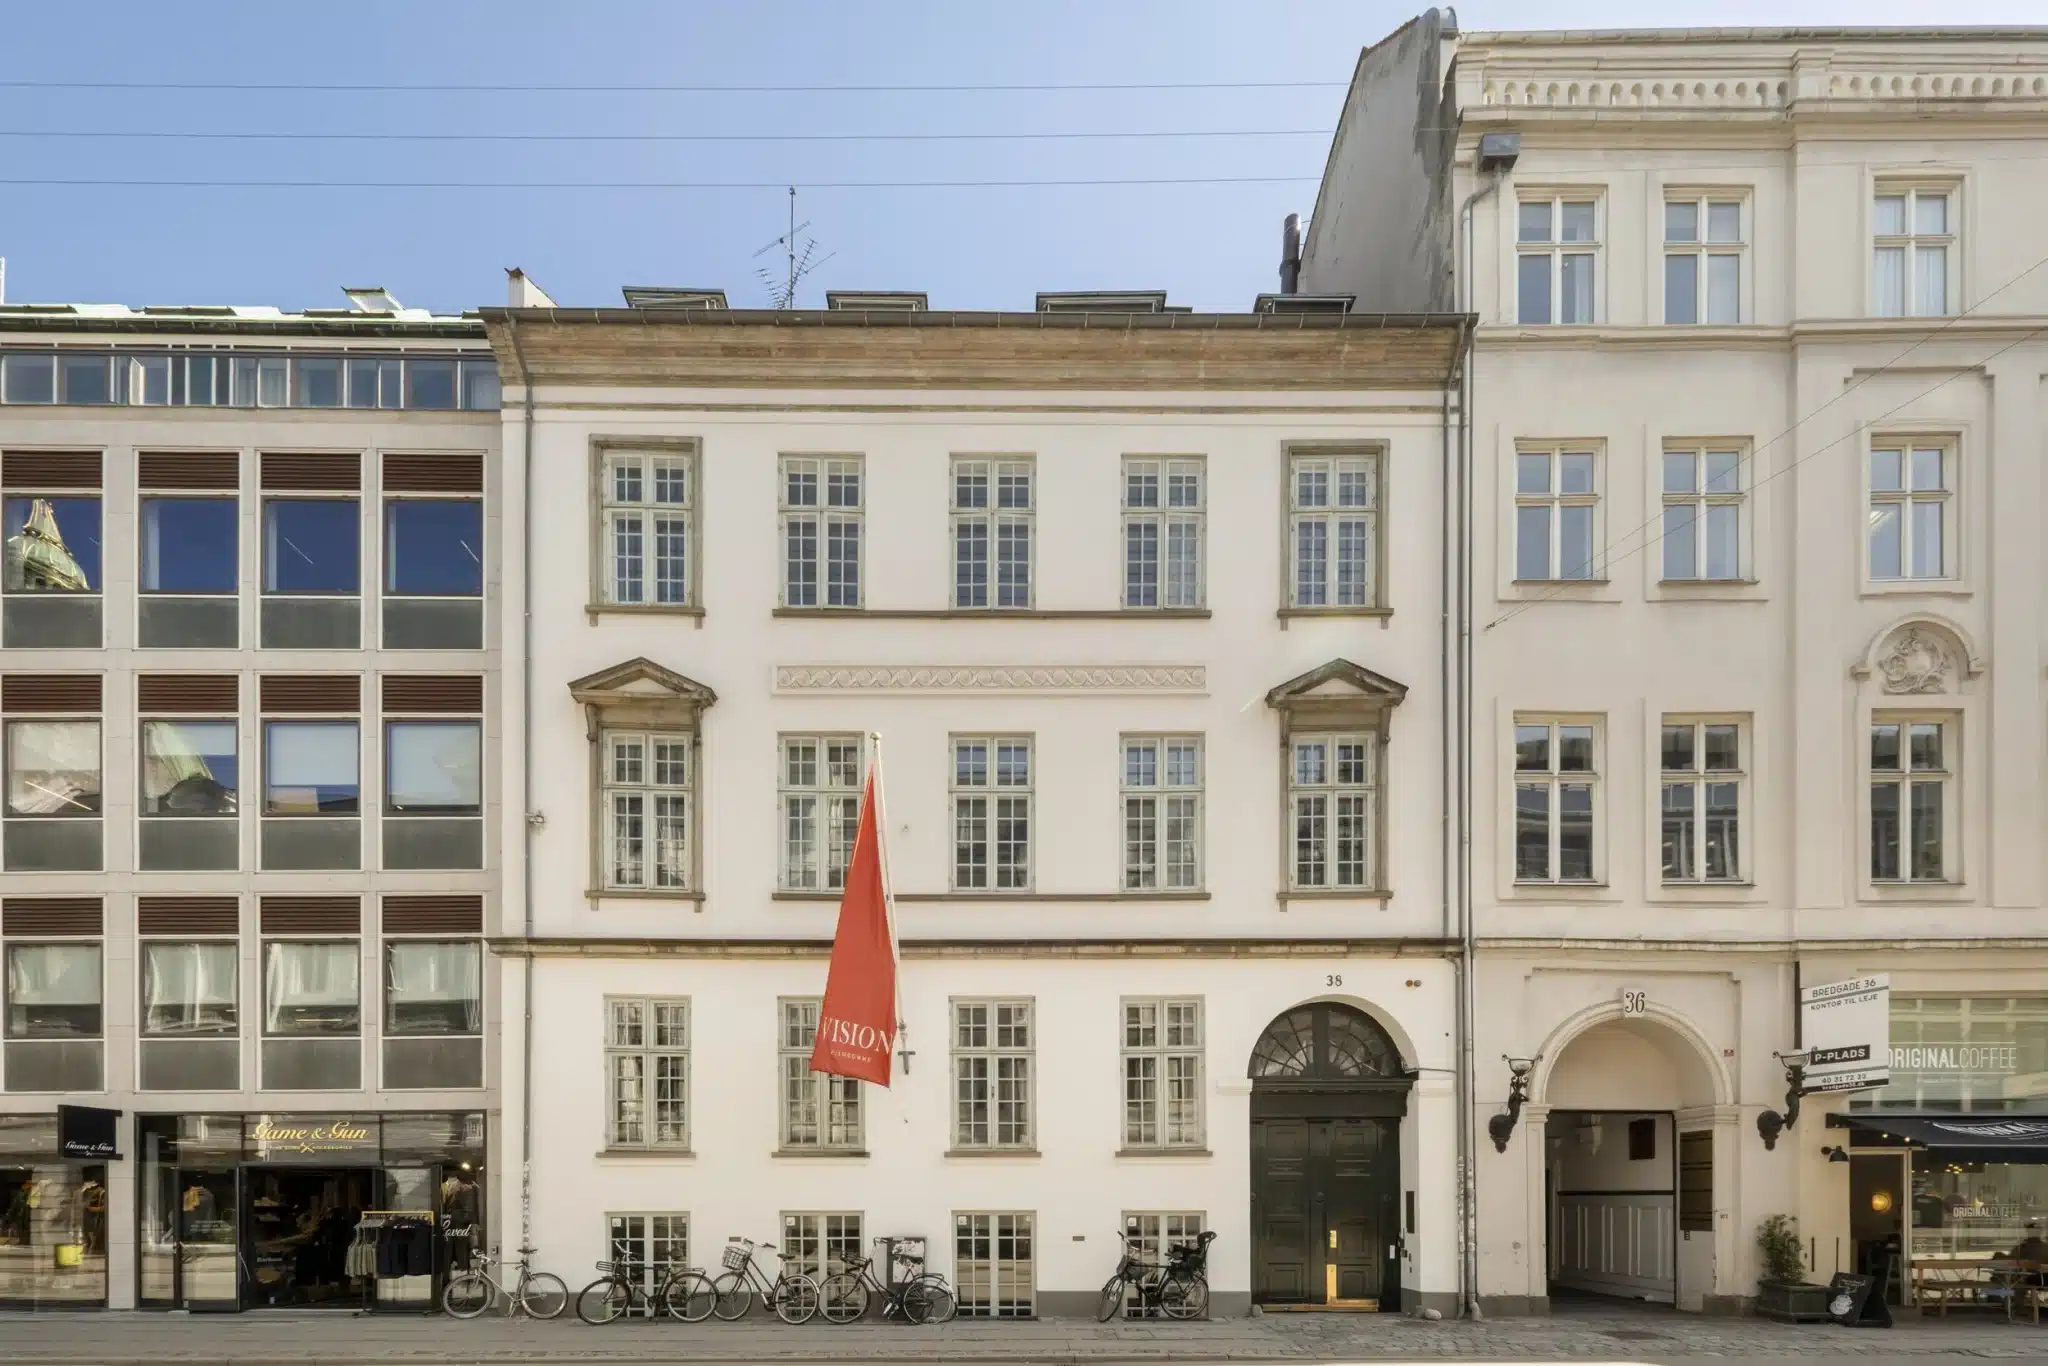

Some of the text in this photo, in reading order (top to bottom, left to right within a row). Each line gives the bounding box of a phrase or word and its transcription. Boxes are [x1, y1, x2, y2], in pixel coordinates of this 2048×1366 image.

[1326, 975, 1343, 987] 38
[1812, 979, 1877, 998] BREDGADE 36
[1625, 991, 1645, 1013] 36
[1810, 1001, 1842, 1010] KONTOR
[1858, 994, 1878, 1002] LEJE
[822, 1016, 894, 1055] VISION
[1815, 1048, 1866, 1062] P-PLADS
[252, 1120, 368, 1140] Game & Gun
